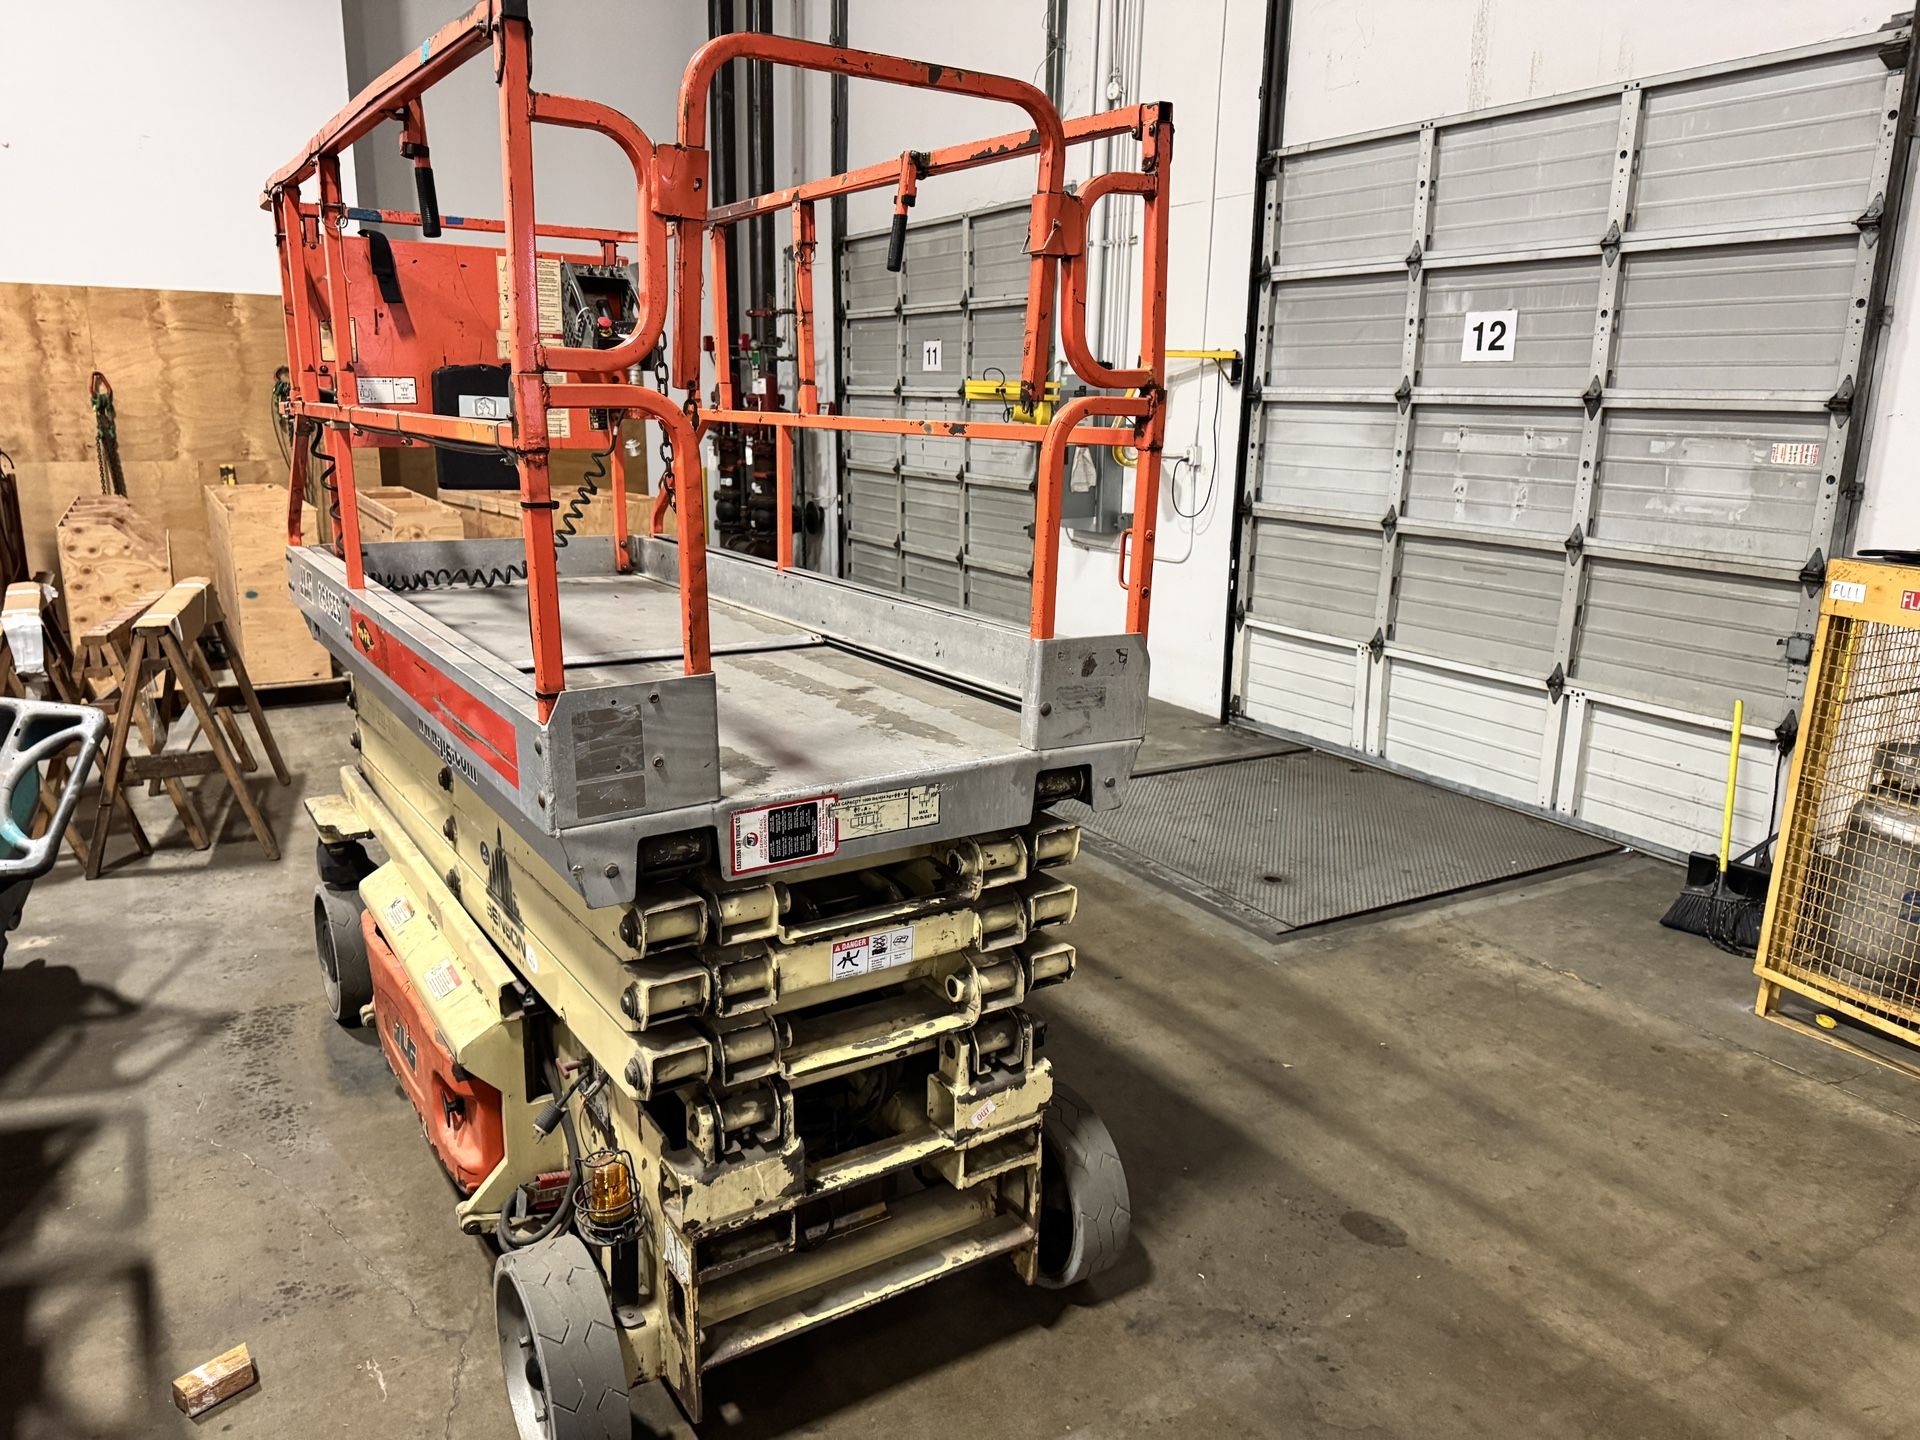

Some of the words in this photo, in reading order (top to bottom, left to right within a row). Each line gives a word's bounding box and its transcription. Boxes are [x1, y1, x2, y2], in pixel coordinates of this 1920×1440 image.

[1472, 320, 1507, 352] 12
[926, 346, 937, 365] 11
[1833, 583, 1860, 600] FULL
[1901, 591, 1920, 611] FL
[417, 716, 478, 786] www.jlg.com
[841, 799, 861, 807] CAPACITY
[486, 900, 527, 960] BENSON
[841, 938, 867, 951] DANGER
[976, 1106, 991, 1122] OUT
